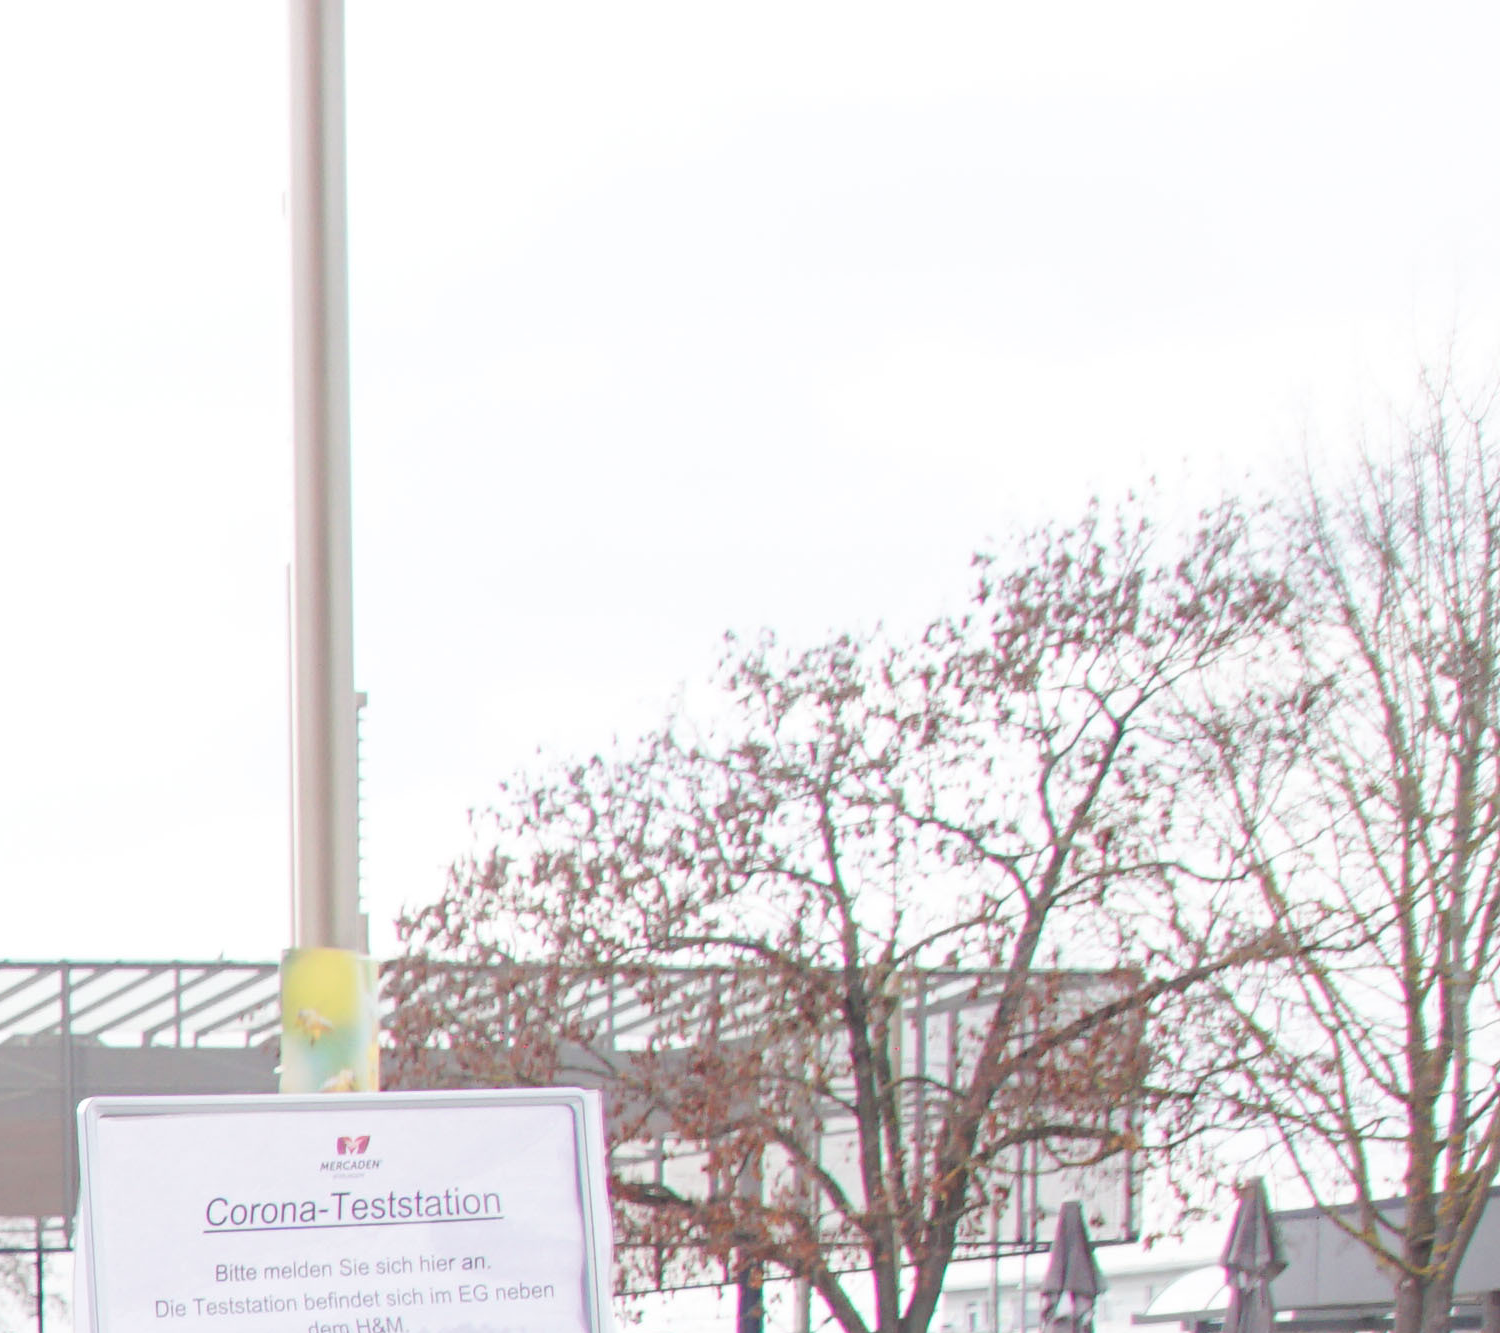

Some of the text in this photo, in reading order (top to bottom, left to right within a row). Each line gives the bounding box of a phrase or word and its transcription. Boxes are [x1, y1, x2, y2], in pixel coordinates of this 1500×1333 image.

[320, 1159, 381, 1172] MERCADEN
[205, 1187, 502, 1227] Corona-Teststation
[215, 1254, 492, 1282] Bitte melden Sie sich hier an.
[155, 1282, 554, 1318] Die Teststation befindet sich im EG neben
